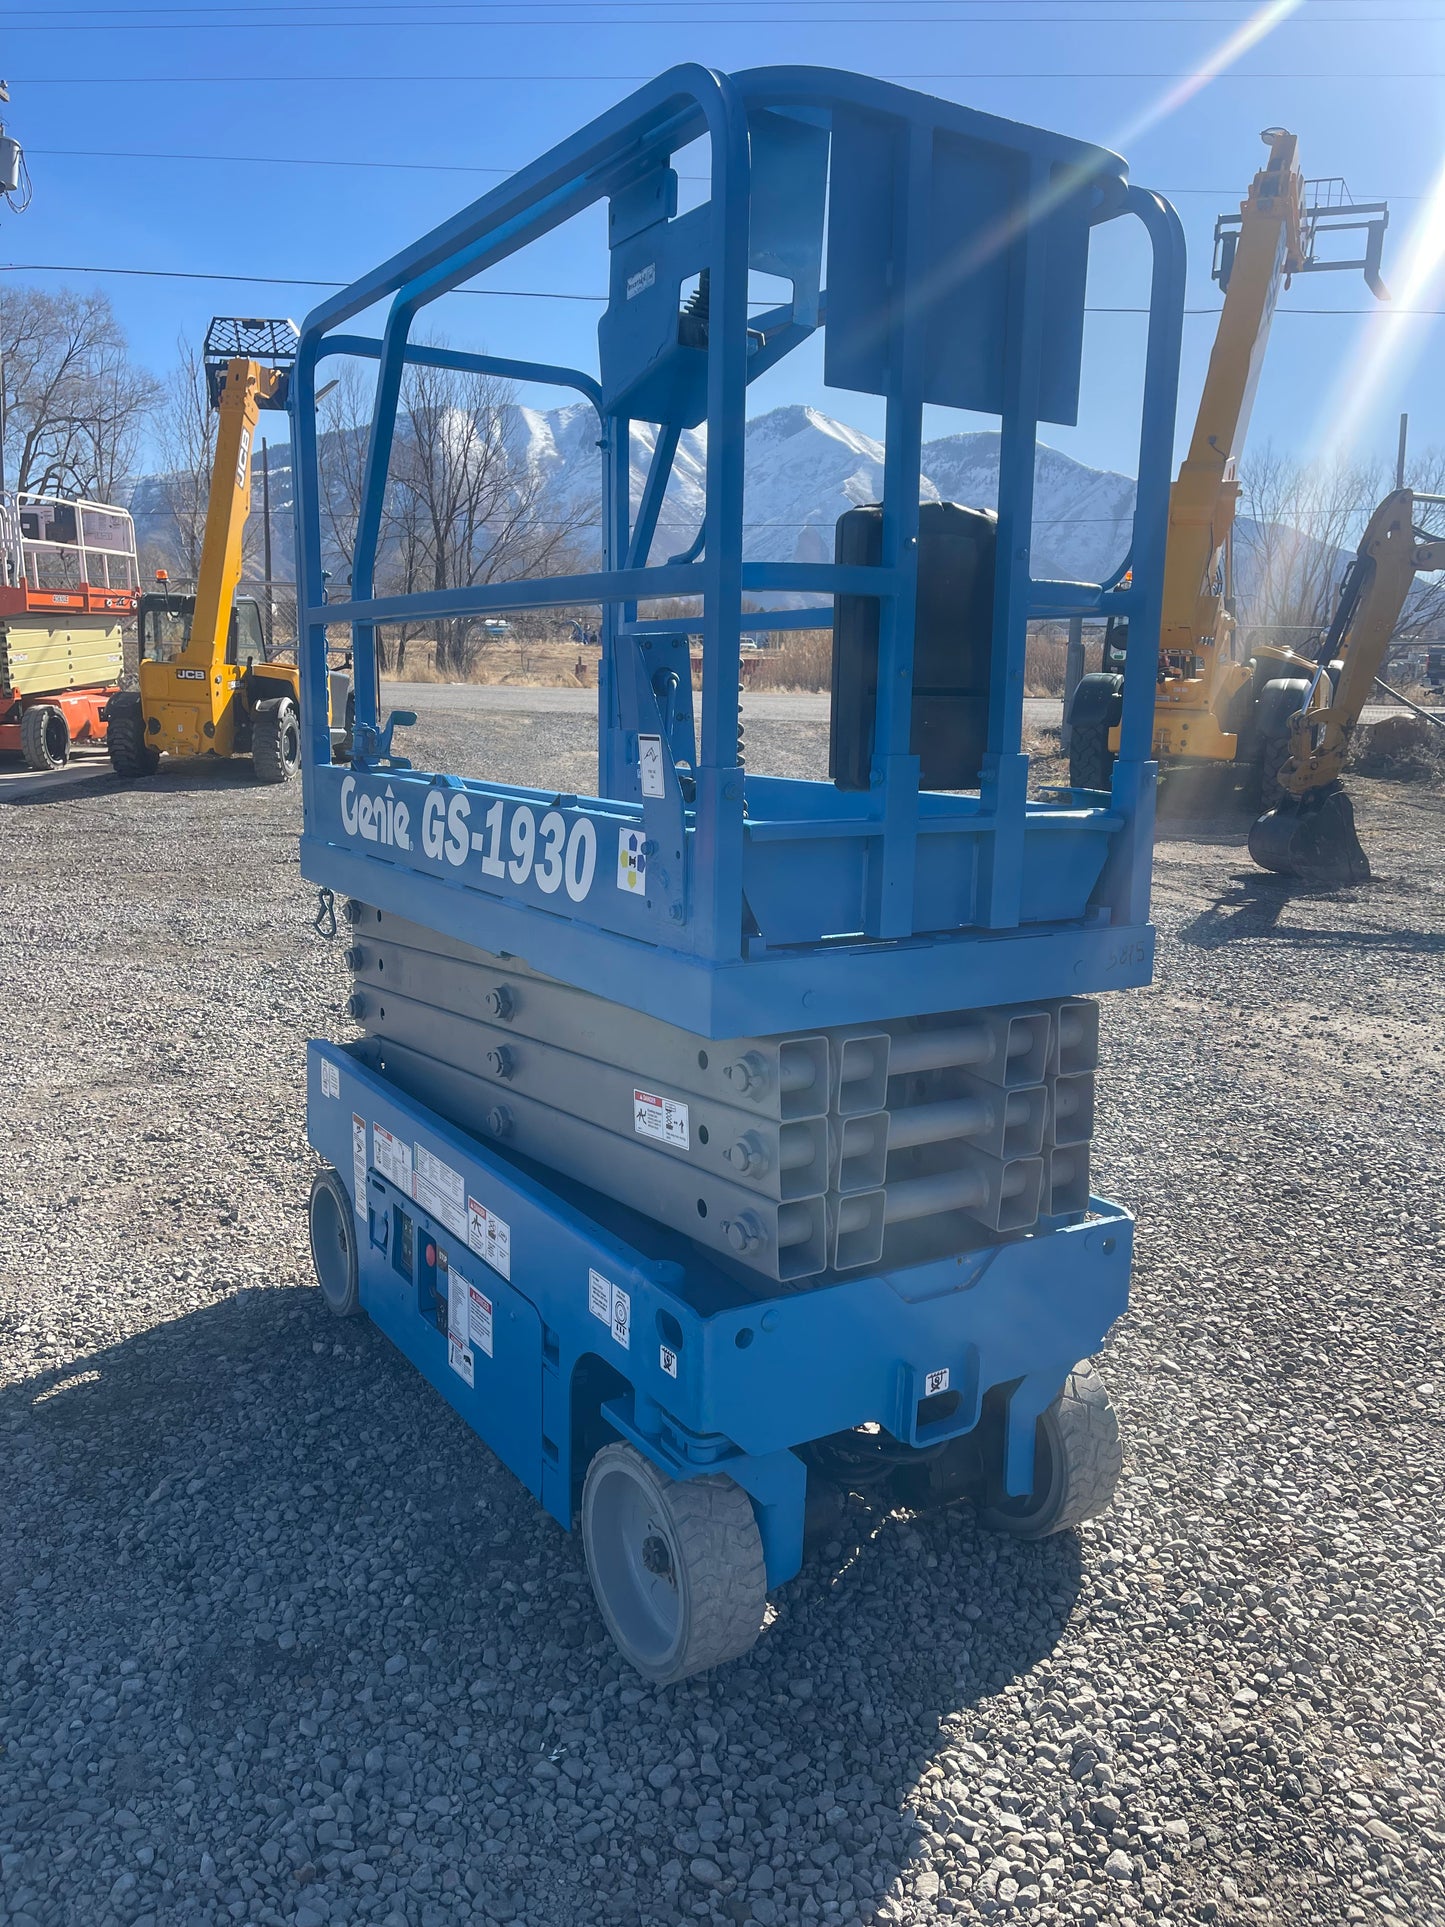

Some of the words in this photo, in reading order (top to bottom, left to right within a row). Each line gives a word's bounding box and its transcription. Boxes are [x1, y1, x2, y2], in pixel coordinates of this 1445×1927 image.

[237, 427, 250, 489] JCB
[177, 670, 205, 679] JCB
[341, 775, 411, 851] Genie
[421, 790, 597, 902] GS-1930
